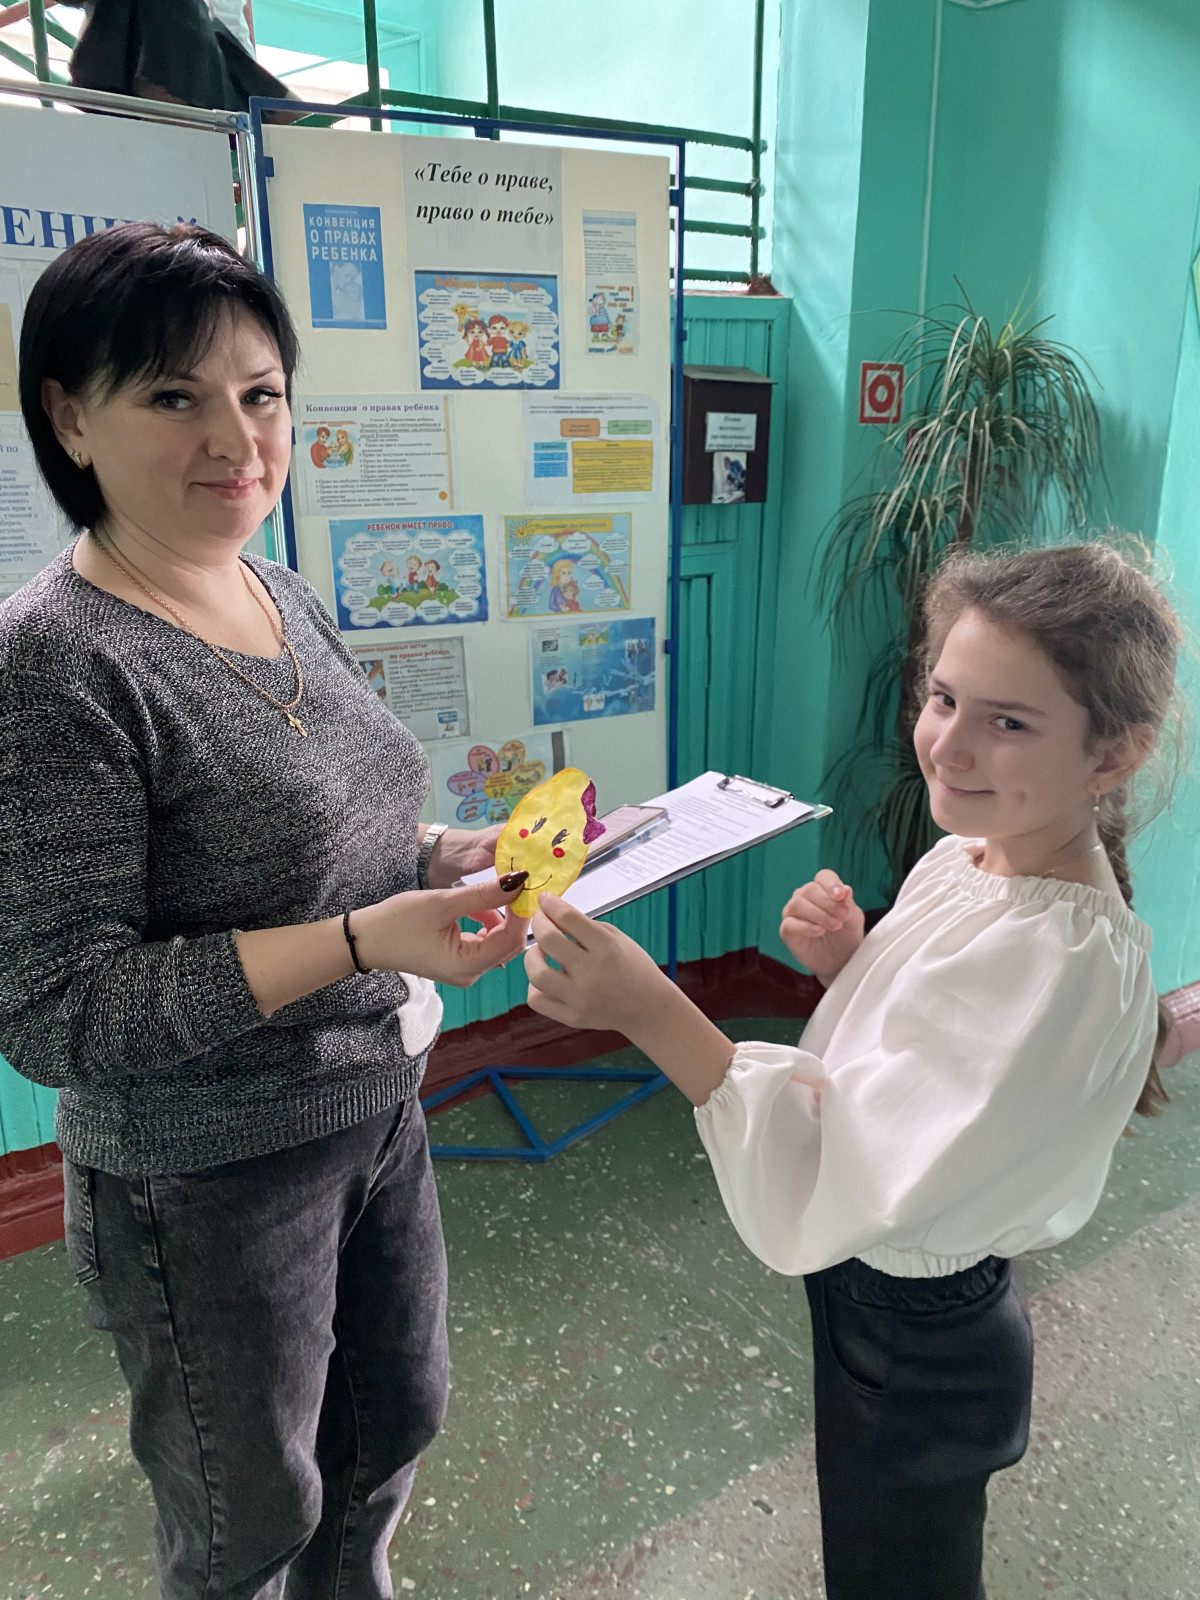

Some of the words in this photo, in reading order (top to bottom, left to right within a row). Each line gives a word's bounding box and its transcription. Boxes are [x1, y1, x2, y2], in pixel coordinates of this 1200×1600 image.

[414, 162, 472, 184] «Тебе
[478, 172, 489, 186] о
[495, 173, 553, 193] праве,
[309, 216, 376, 229] КОНВЕНЦИЯ
[416, 205, 474, 224] право
[480, 208, 491, 222] о
[497, 206, 554, 225] тебе»
[310, 229, 320, 244] О
[324, 230, 377, 246] ПРАВАХ
[311, 246, 378, 262] РЕБЕНКА
[370, 405, 402, 414] правах
[404, 402, 440, 413] ребёнка
[367, 523, 401, 531] РЕБЕНОК
[402, 522, 427, 530] ИМЕЕТ
